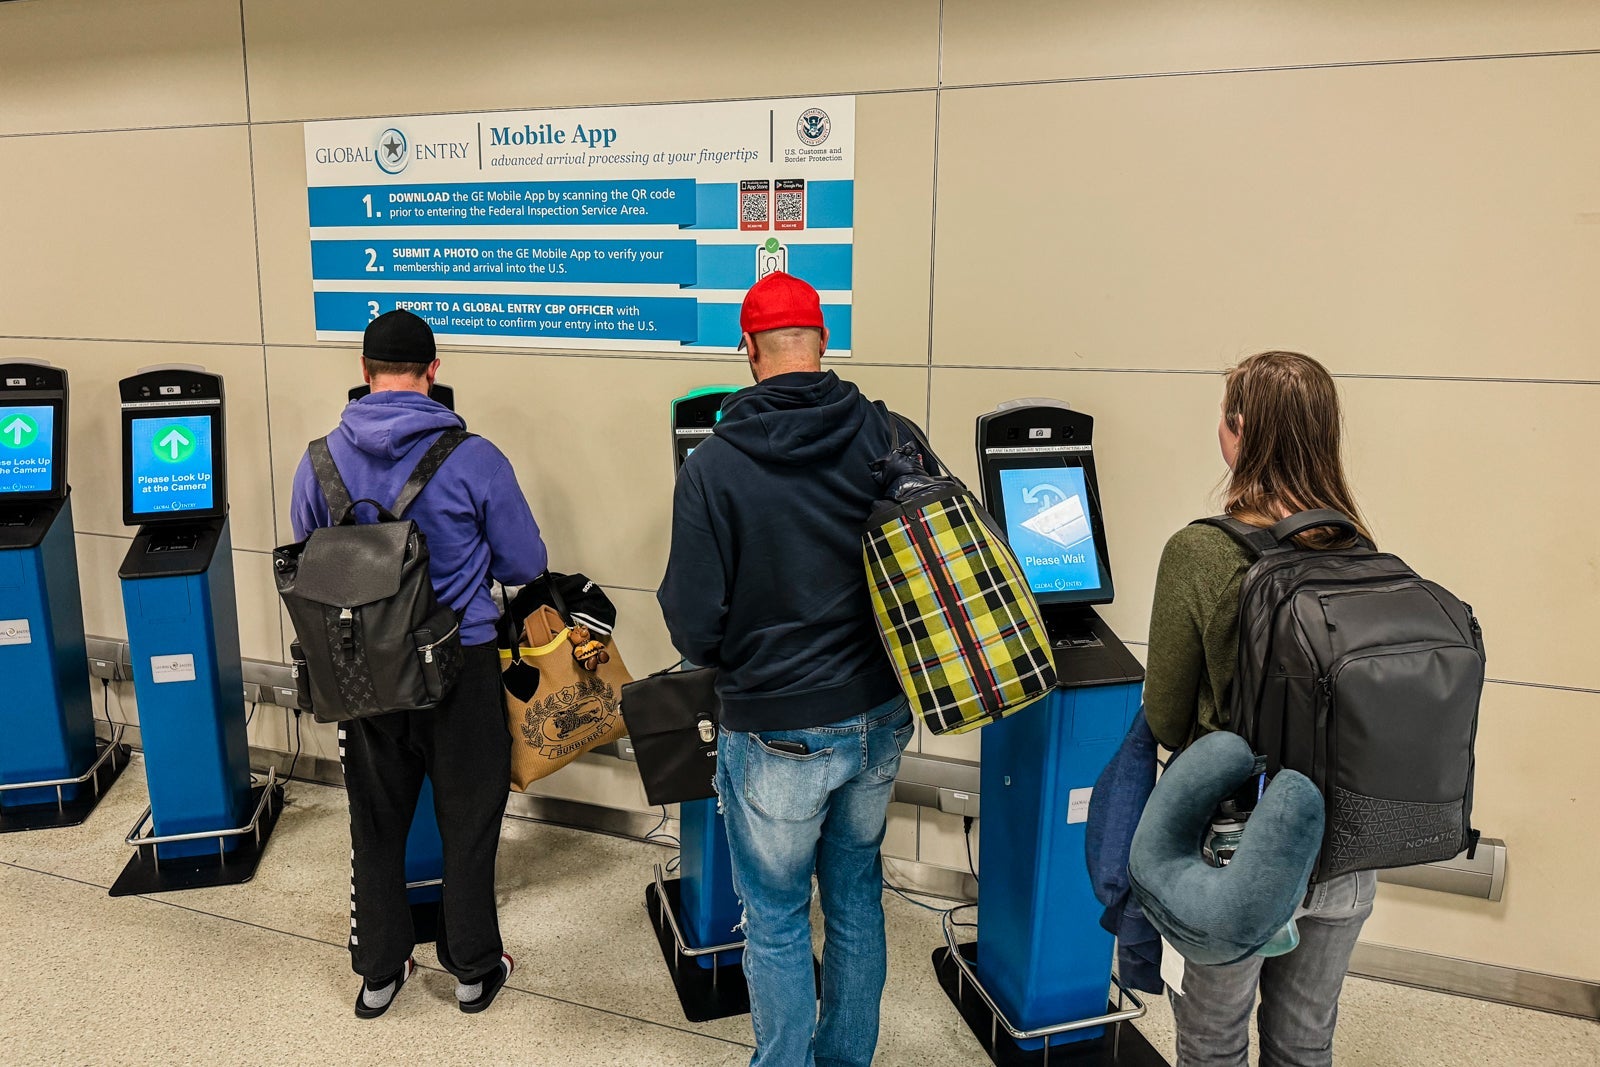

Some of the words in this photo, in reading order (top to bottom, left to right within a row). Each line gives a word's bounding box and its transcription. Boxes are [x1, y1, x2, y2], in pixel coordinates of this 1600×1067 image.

[490, 124, 566, 146] Mobile
[571, 124, 617, 148] App
[315, 146, 373, 164] GLOBAL
[416, 143, 469, 160] ENTRY
[491, 153, 544, 166] advanced
[546, 152, 586, 165] arrival
[588, 151, 649, 167] processing
[653, 152, 665, 163] at
[668, 152, 697, 165] your
[697, 147, 759, 164] fingertips
[808, 154, 843, 162] Protection
[362, 194, 382, 218] 1.
[389, 192, 450, 203] DOWNLOAD
[452, 192, 468, 202] the
[471, 191, 484, 201] GE
[487, 190, 521, 201] Mobile
[524, 190, 545, 203] App
[548, 190, 560, 203] by
[562, 189, 608, 202] scanning
[610, 189, 628, 200] the
[631, 189, 647, 200] QR
[649, 188, 676, 199] code
[390, 207, 411, 219] prior
[414, 208, 425, 217] to
[427, 206, 467, 218] entering
[469, 206, 486, 216] the
[488, 205, 524, 216] Federal
[527, 205, 579, 218] Inspection
[581, 205, 617, 216] Service
[620, 205, 649, 215] Area.
[364, 248, 385, 272] 2.
[392, 248, 430, 259] SUBMIT
[433, 248, 442, 258] A
[444, 248, 479, 259] PHOTO
[481, 251, 494, 259] on
[496, 248, 513, 259] the
[515, 248, 529, 259] GE
[532, 248, 567, 259] Mobile
[570, 248, 591, 261] App
[593, 250, 605, 260] to
[607, 248, 637, 262] verify
[639, 250, 664, 263] your
[393, 262, 450, 274] membership
[452, 262, 470, 273] and
[473, 262, 504, 273] arrival
[506, 263, 526, 273] into
[528, 263, 545, 273] the
[548, 263, 567, 274] U.S.
[395, 301, 433, 311] REPORT
[436, 302, 449, 311] TO
[452, 302, 460, 311] A
[463, 302, 505, 313] GLOBAL
[507, 303, 542, 314] ENTRY
[545, 304, 566, 314] CBP
[568, 304, 614, 315] OFFICER
[616, 305, 640, 316] with
[422, 316, 449, 326] irtual
[451, 316, 484, 328] receipt
[487, 317, 497, 327] to
[499, 317, 537, 328] confirm
[539, 320, 561, 331] your
[564, 320, 591, 332] entry
[594, 319, 614, 330] into
[617, 320, 635, 331] the
[637, 320, 657, 331] U.S.
[14, 458, 36, 466] Look
[38, 457, 50, 466] Up
[138, 475, 169, 484] Please
[172, 473, 195, 482] Look
[197, 472, 211, 482] Up
[142, 485, 151, 493] at
[153, 485, 168, 493] the
[171, 483, 207, 491] Camera
[1025, 556, 1060, 567] Please
[1061, 553, 1086, 564] Wait
[557, 729, 605, 756] BURBERRY
[1405, 831, 1456, 849] NOMATIC
